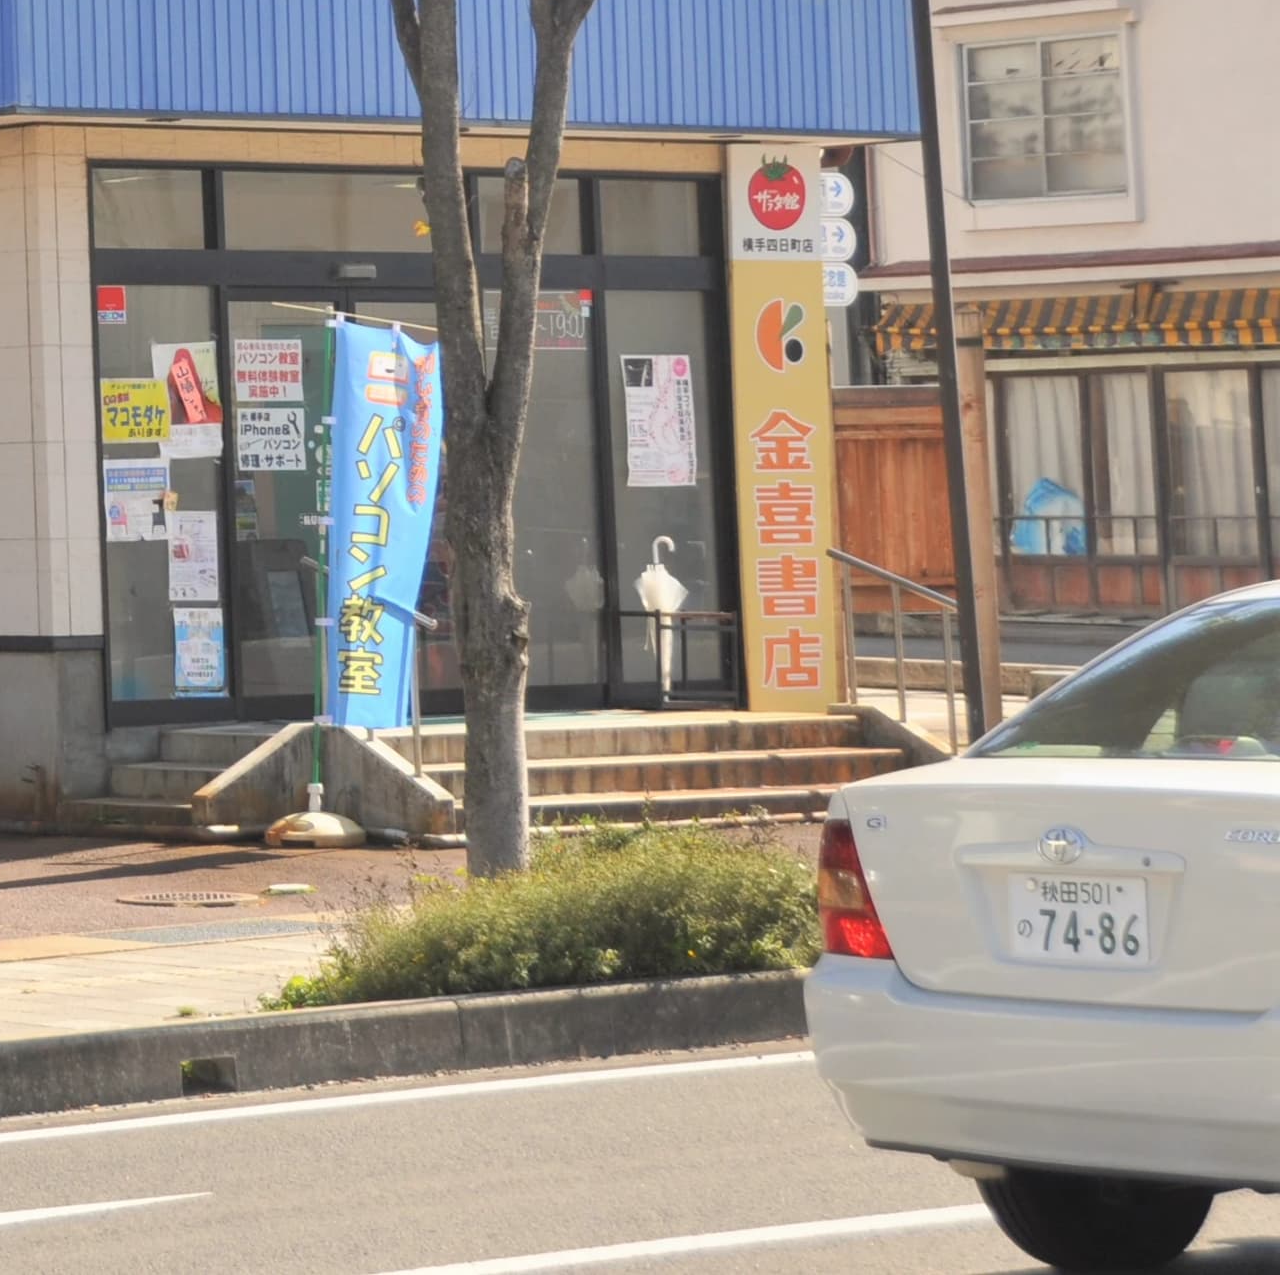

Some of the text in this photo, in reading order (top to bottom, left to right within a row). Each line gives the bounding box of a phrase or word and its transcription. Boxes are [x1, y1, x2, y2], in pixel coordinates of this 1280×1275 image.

[743, 237, 814, 253] 横手四日町店
[237, 351, 300, 365] パソコン教室
[237, 370, 300, 384] 無料体験教室
[106, 405, 166, 427] マコモダケ
[240, 424, 290, 435] iPhone&
[263, 439, 301, 450] パソコン
[337, 413, 407, 695] パソコン教室
[748, 408, 824, 691] 金喜書店
[1040, 880, 1112, 905] 秋田501
[1017, 908, 1140, 956] の 74-86
